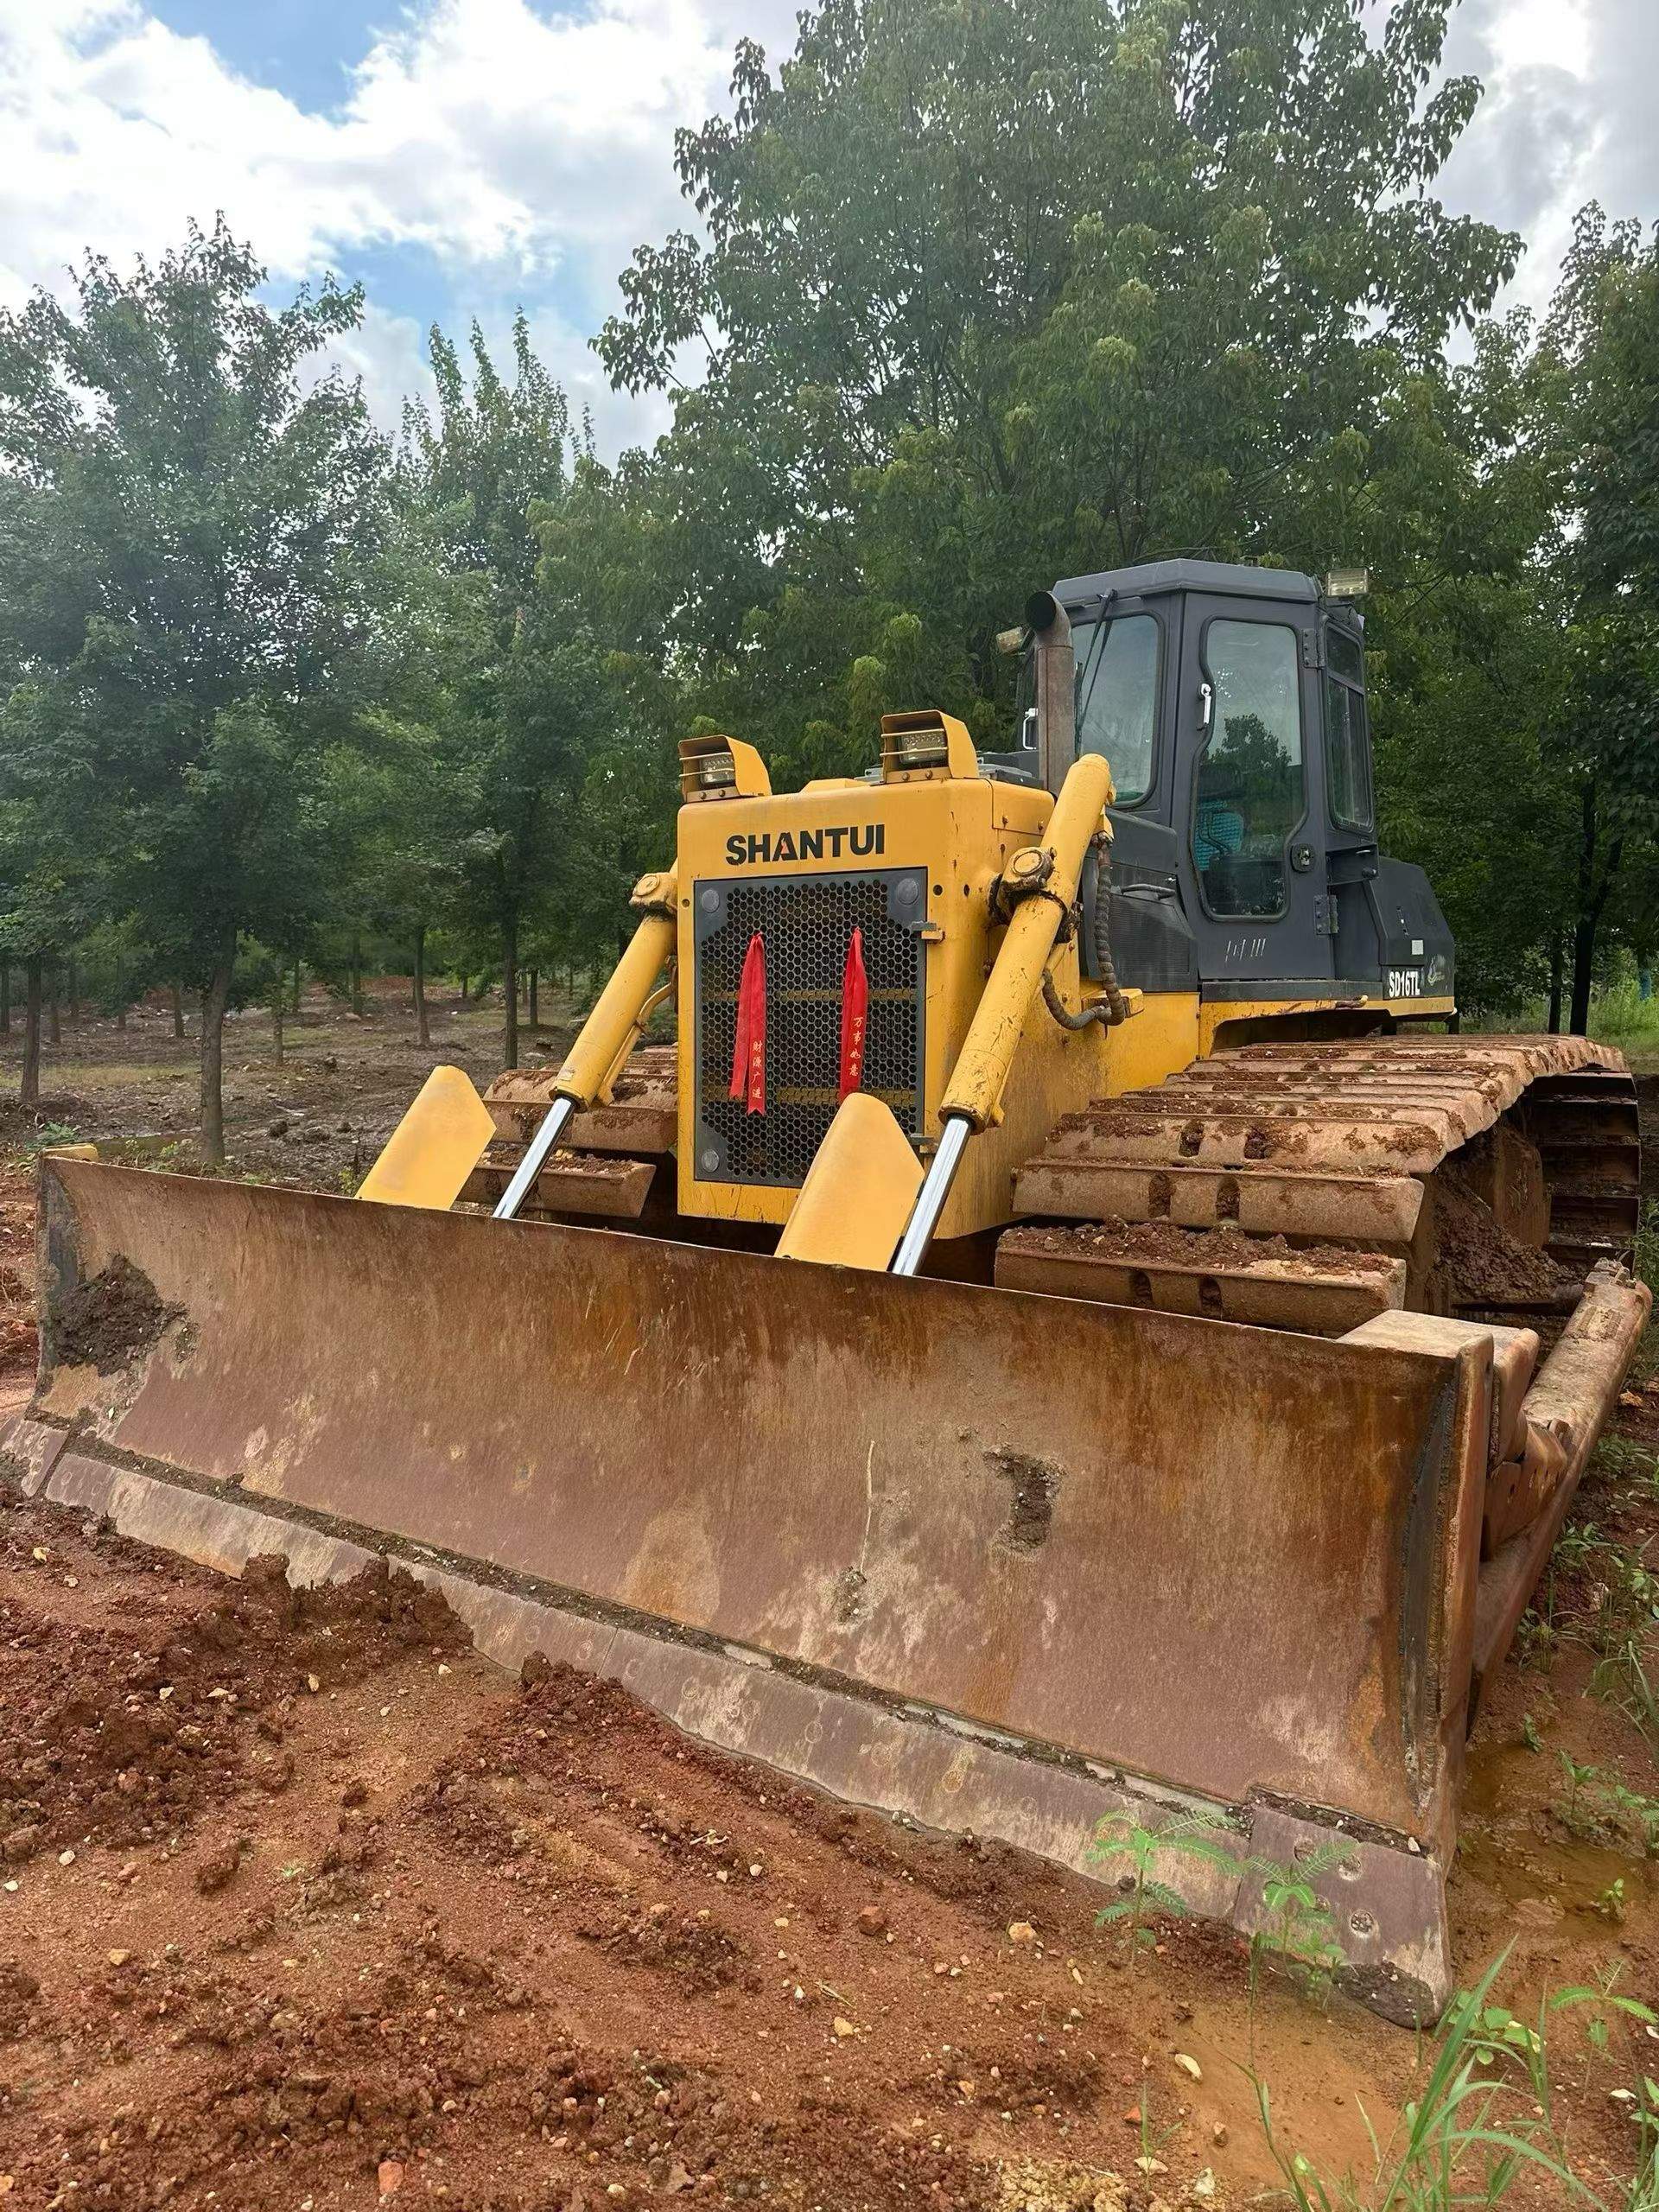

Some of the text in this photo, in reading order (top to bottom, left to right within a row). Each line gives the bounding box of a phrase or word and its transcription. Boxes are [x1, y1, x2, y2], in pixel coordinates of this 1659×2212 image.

[726, 823, 886, 866] SHANTUI
[1389, 970, 1421, 998] SD16TL
[849, 1016, 864, 1077] 万事如意
